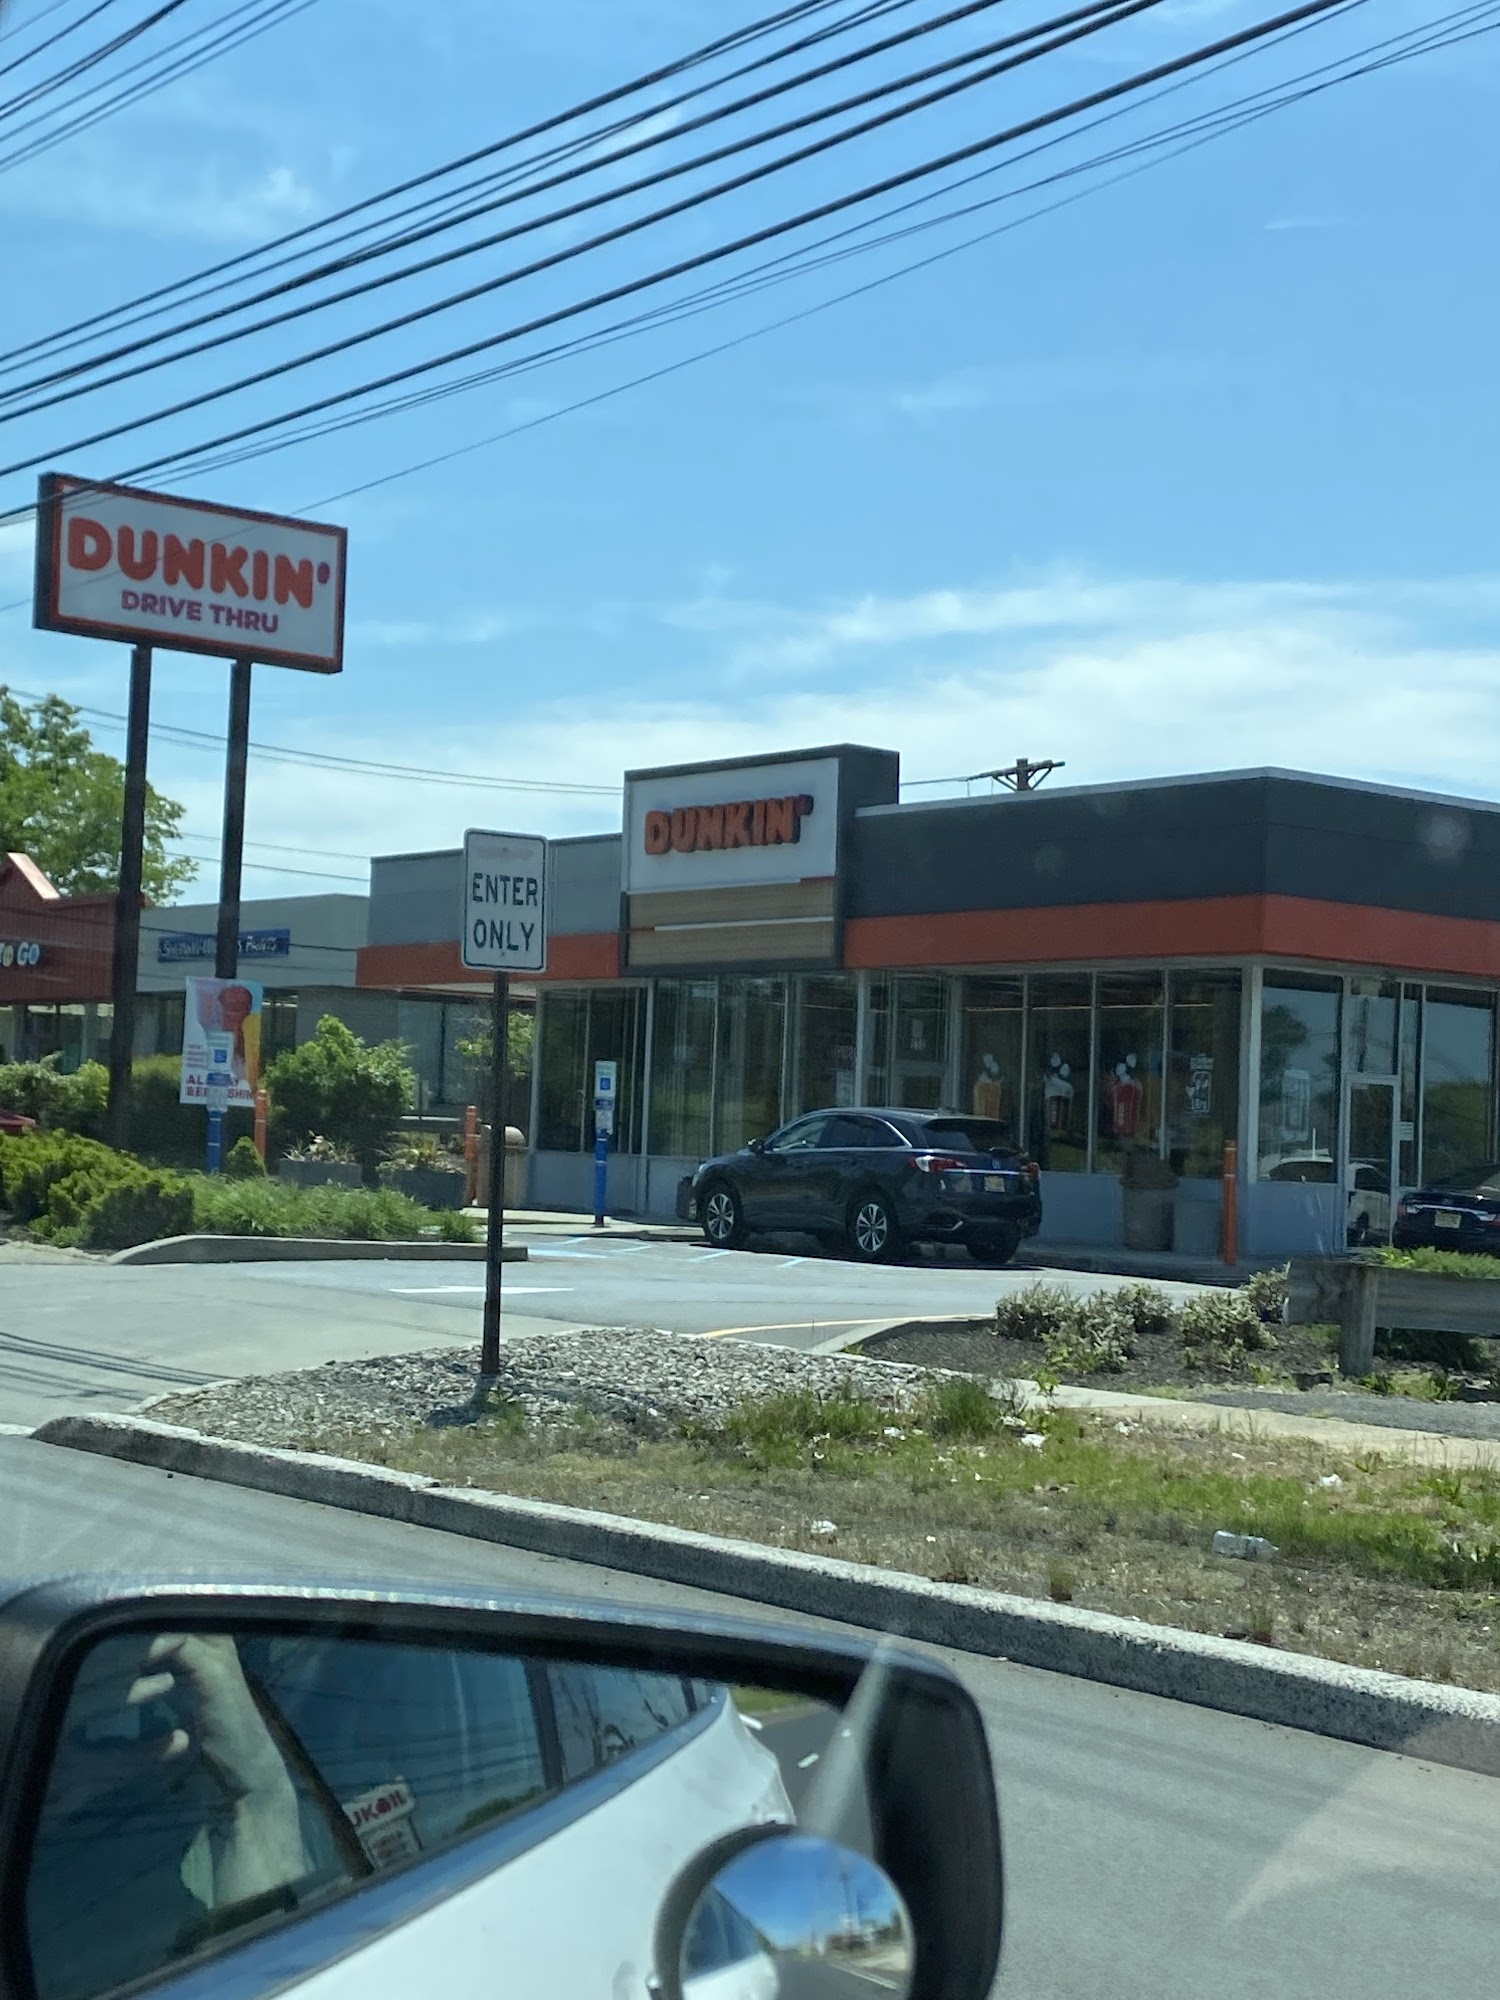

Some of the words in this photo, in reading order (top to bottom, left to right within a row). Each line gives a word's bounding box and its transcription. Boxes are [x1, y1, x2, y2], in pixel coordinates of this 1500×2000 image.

[68, 517, 330, 609] DUNKIN'
[121, 590, 202, 622] DRIVE
[208, 603, 279, 633] THRU
[644, 794, 814, 856] DUNKIN'
[472, 872, 538, 907] ENTER
[17, 942, 40, 965] GO
[473, 918, 535, 952] ONLY
